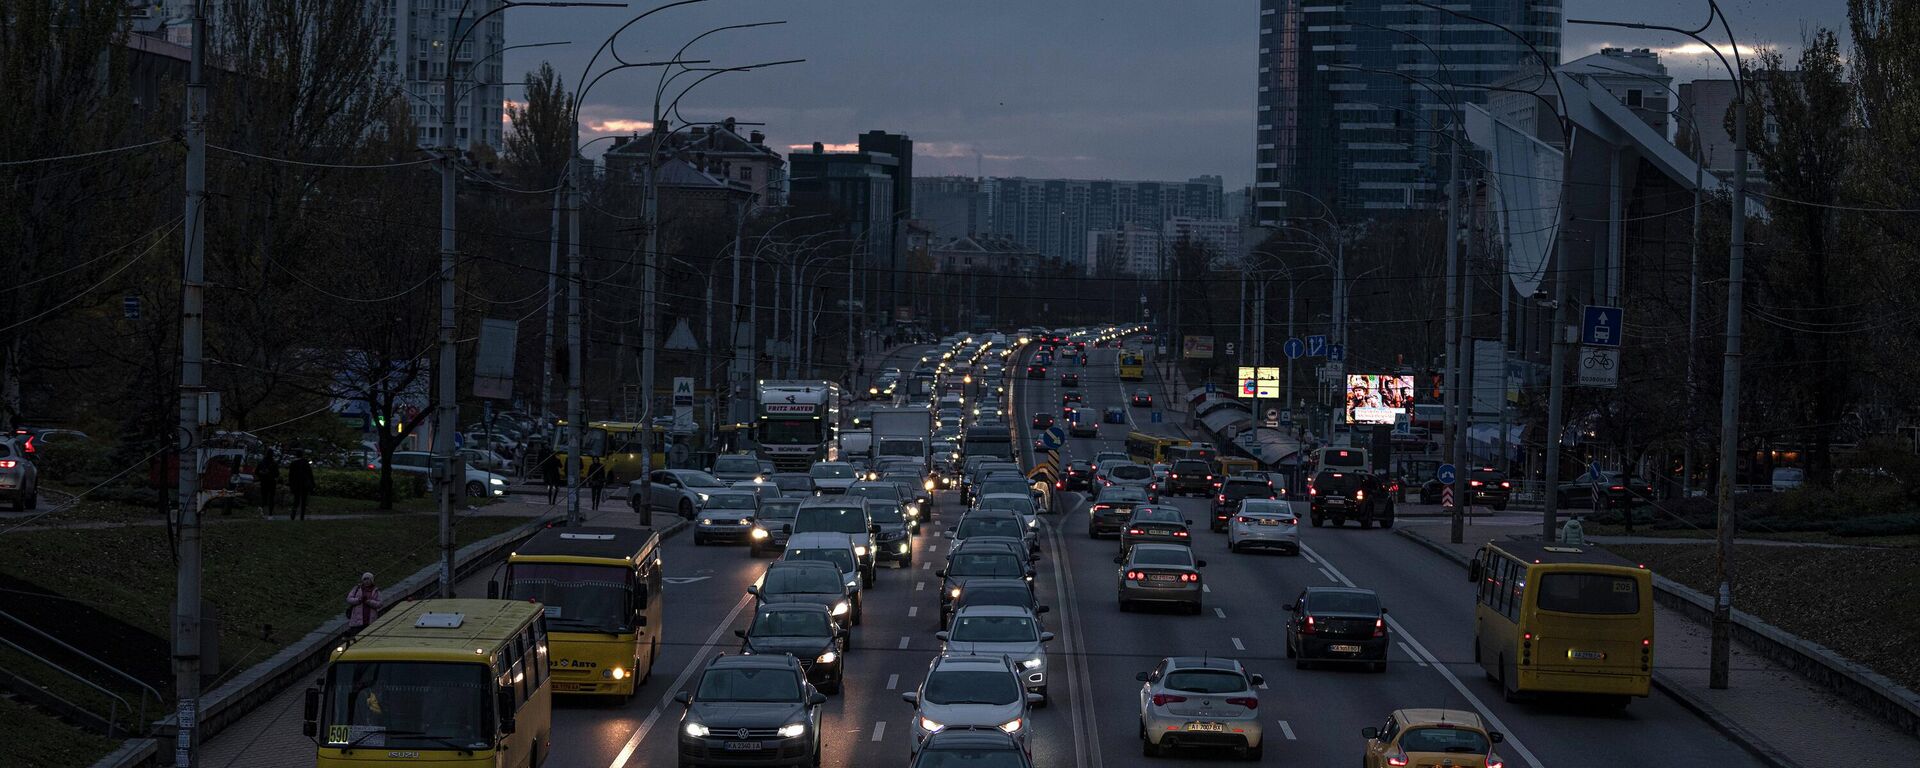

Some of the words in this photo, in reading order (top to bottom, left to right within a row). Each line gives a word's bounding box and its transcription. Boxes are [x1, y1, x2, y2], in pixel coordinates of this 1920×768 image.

[1615, 583, 1631, 591] 205
[329, 727, 348, 743] 590
[387, 751, 419, 759] ISUZU
